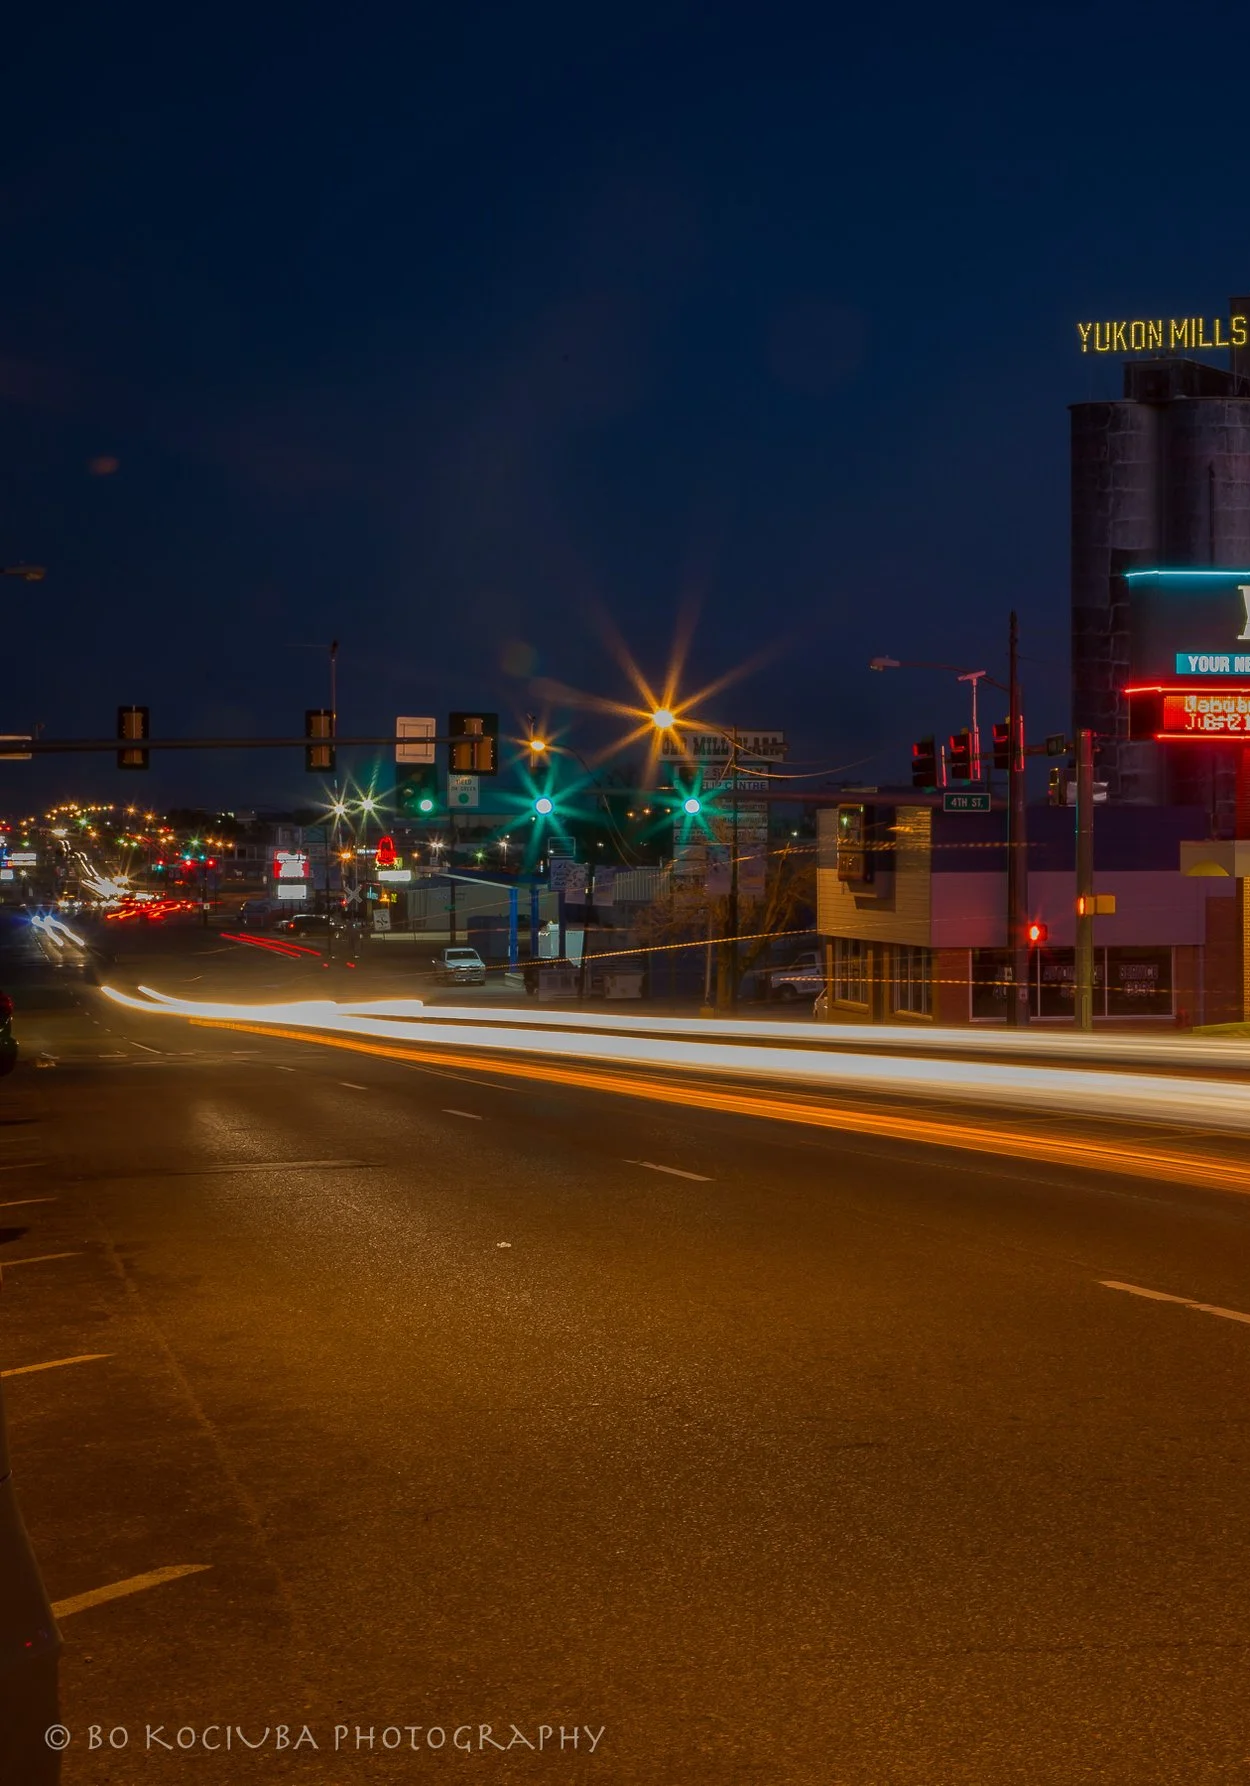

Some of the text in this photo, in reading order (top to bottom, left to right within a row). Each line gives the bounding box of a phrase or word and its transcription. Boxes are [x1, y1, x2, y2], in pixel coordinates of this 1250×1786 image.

[1077, 316, 1247, 352] YUKON MILLS
[1188, 655, 1230, 673] YOUR
[724, 781, 767, 790] CNTRE
[951, 797, 968, 807] 4TH
